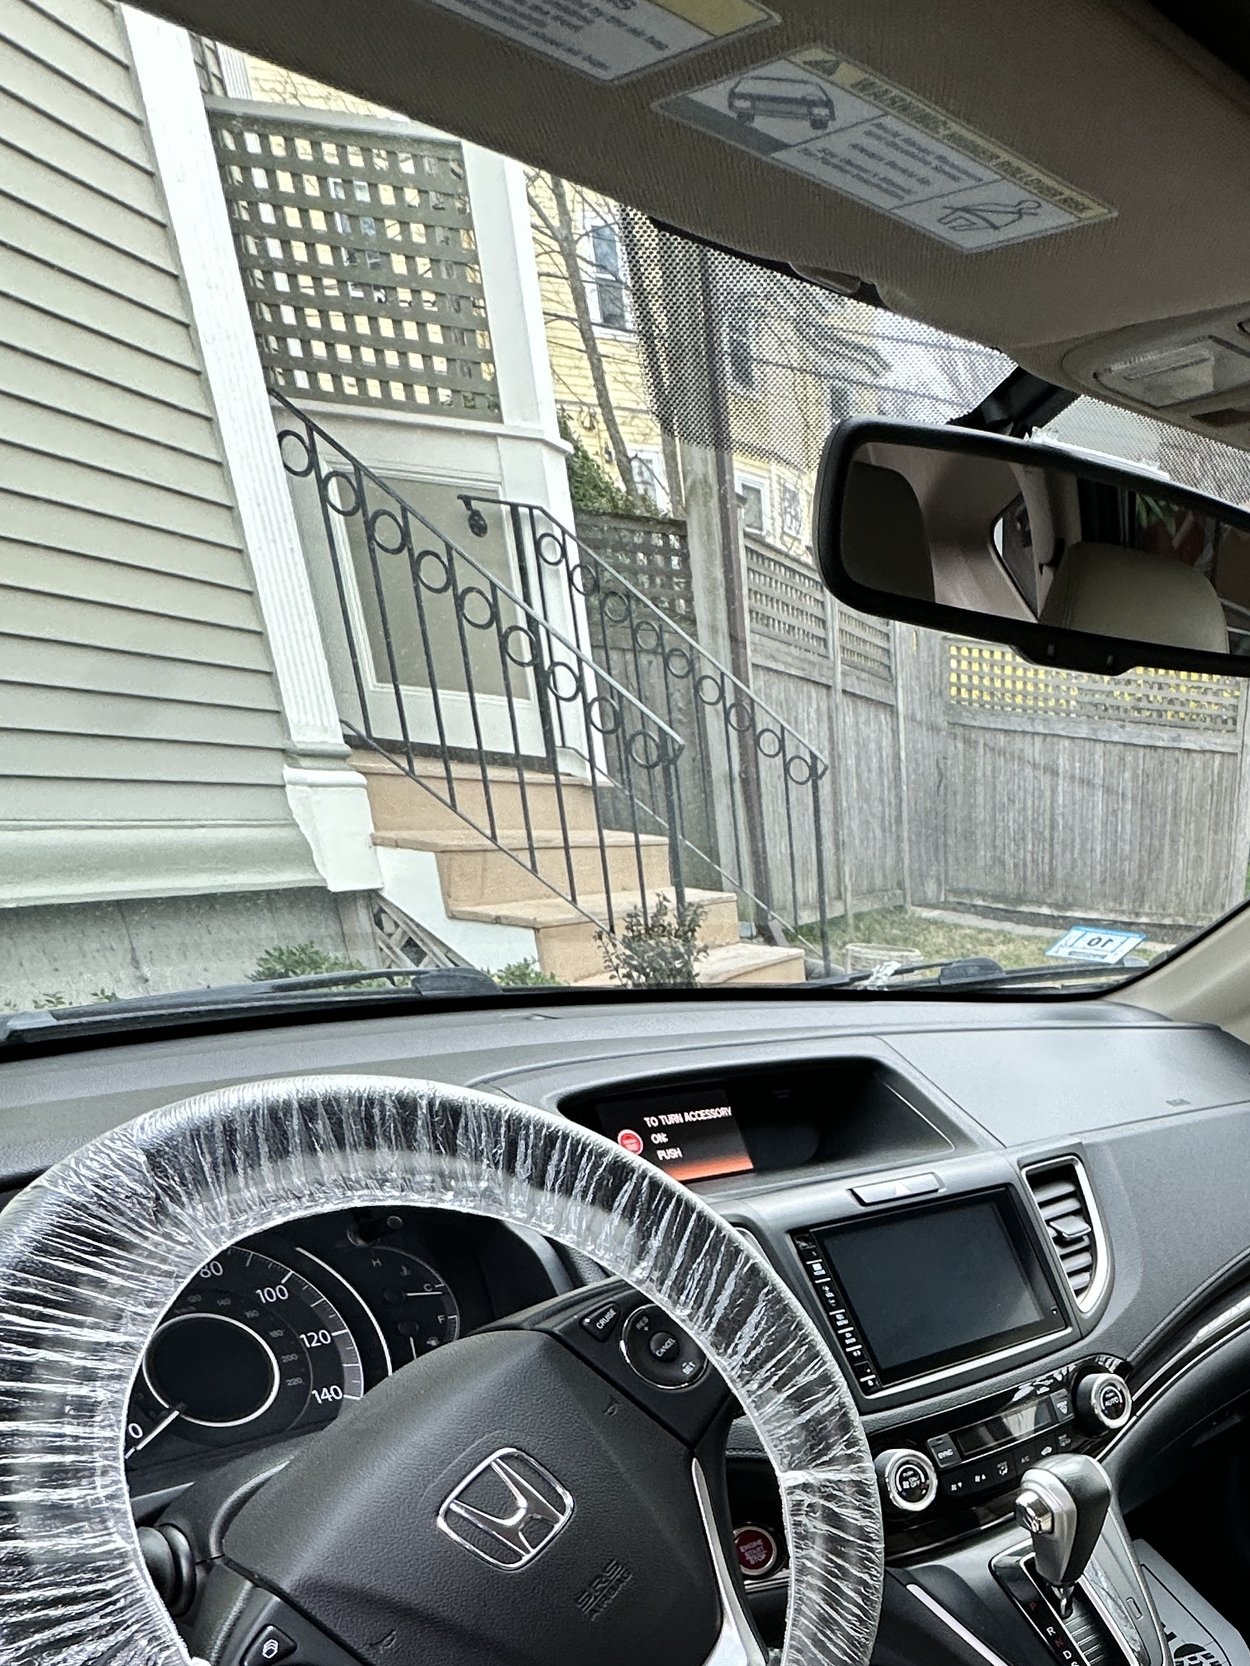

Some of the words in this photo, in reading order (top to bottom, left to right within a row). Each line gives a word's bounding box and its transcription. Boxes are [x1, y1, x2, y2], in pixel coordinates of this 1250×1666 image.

[644, 1115, 659, 1128] TO
[659, 1111, 684, 1126] TURN
[684, 1106, 732, 1122] ACCESSORY
[657, 1147, 683, 1160] PUSH
[200, 1260, 223, 1279] 80
[255, 1284, 289, 1304] 100
[595, 1308, 616, 1329] CRUISE
[300, 1329, 331, 1348] 120
[655, 1338, 676, 1357] CANCEL
[312, 1385, 344, 1404] 140
[128, 1422, 143, 1439] 0
[1046, 1626, 1056, 1636] R
[1063, 1650, 1072, 1659] D
